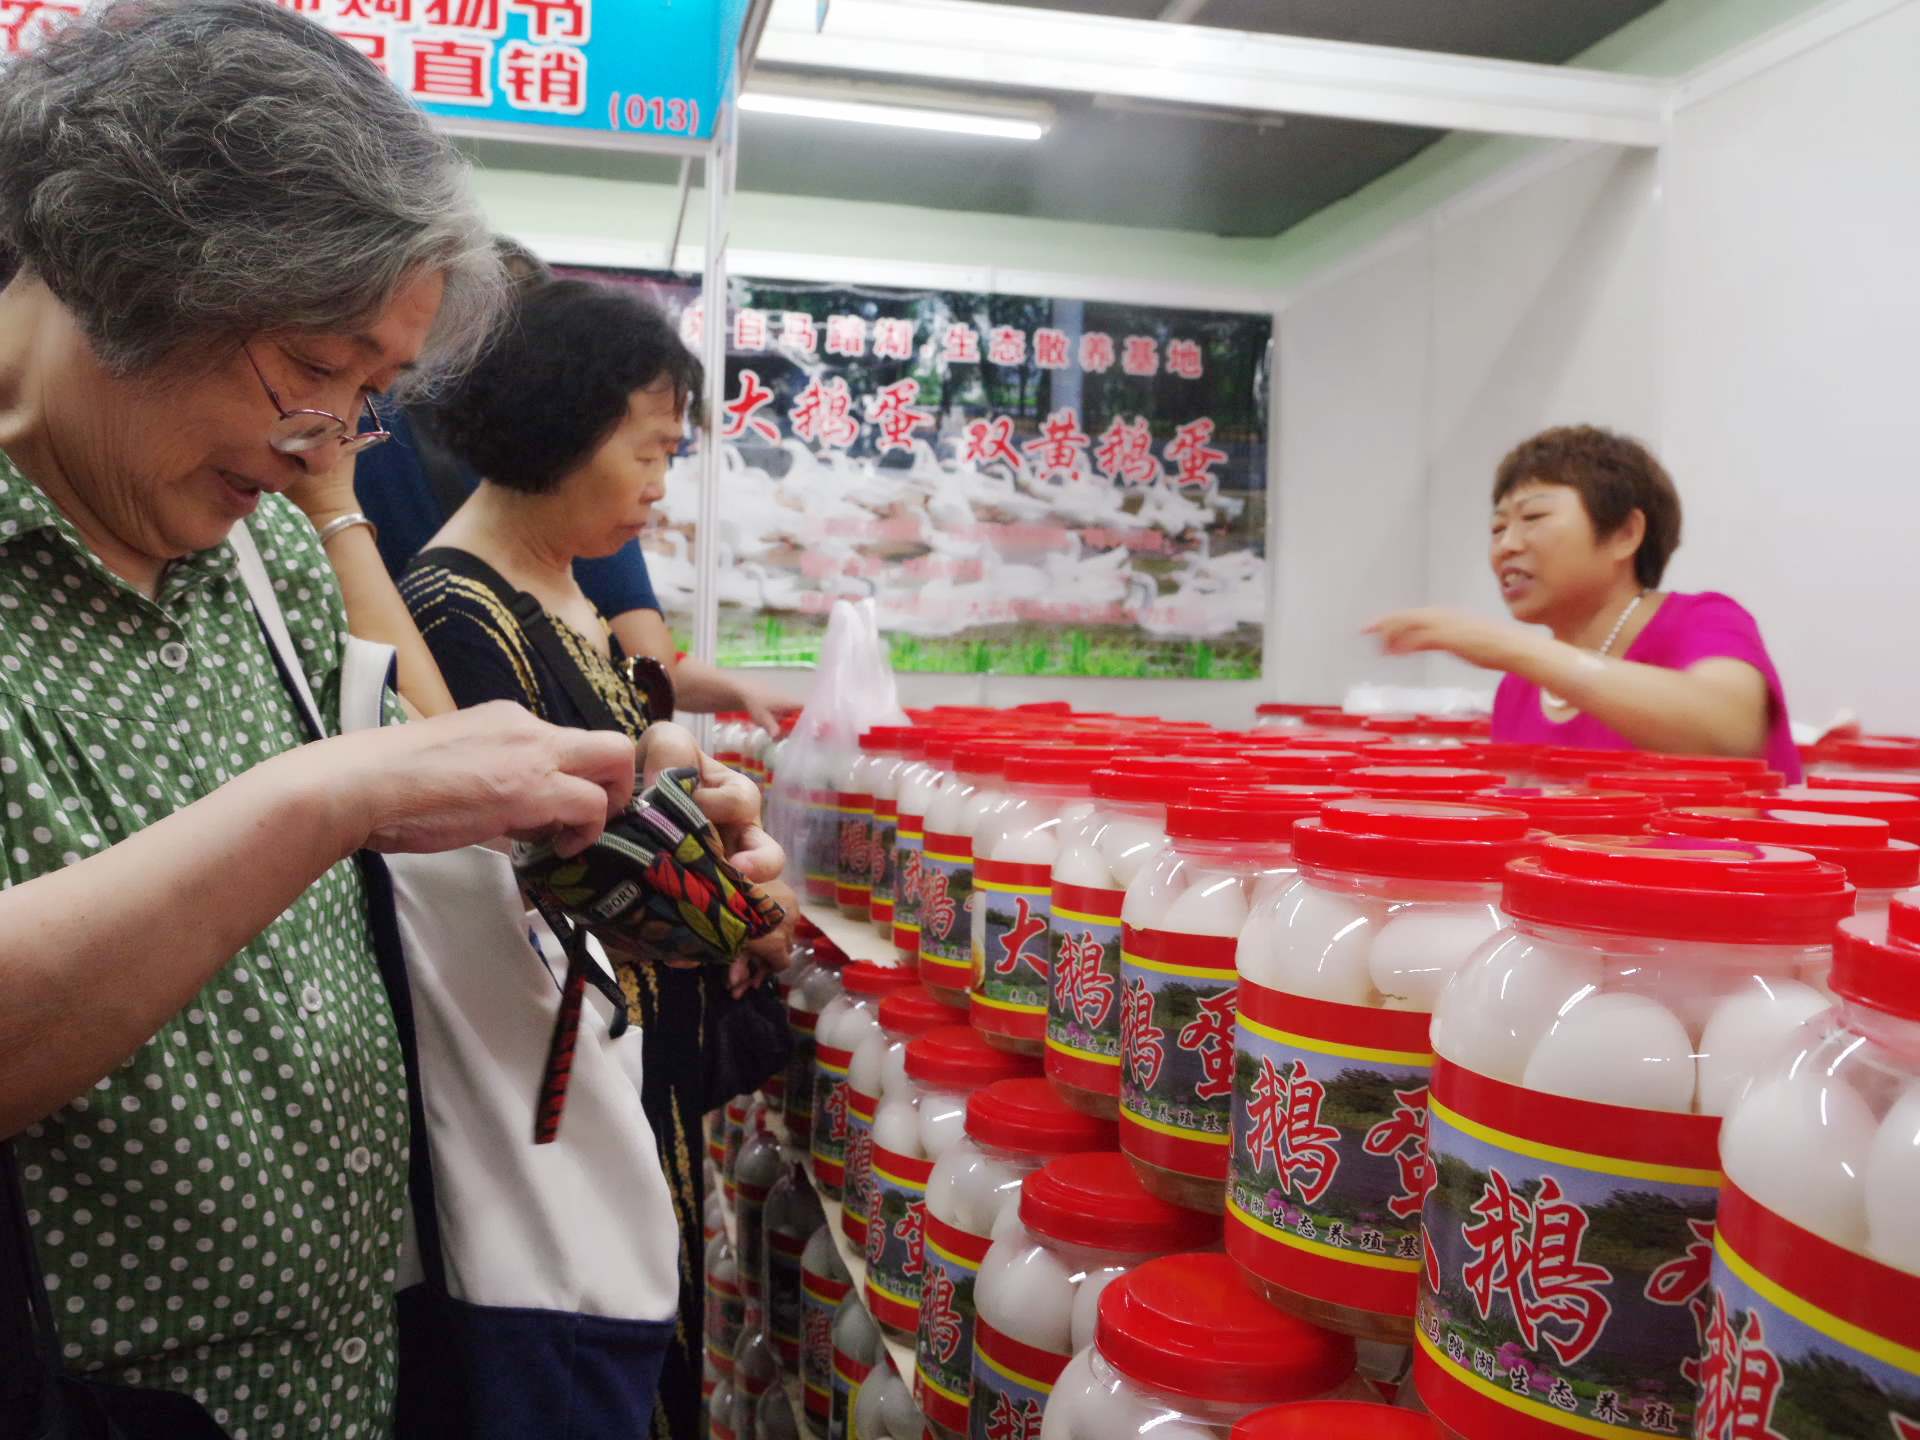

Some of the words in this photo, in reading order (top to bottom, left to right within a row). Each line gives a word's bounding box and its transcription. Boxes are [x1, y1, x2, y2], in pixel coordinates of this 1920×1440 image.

[611, 93, 699, 132] (013)
[944, 323, 1203, 378] 生态散养基地
[721, 371, 936, 449] 大鹅蛋
[964, 408, 1229, 485] 双黄鹅蛋
[994, 896, 1048, 983] 大
[1055, 930, 1114, 1029] 鹅
[1418, 1302, 1677, 1433] 马踏湖生态养殖
